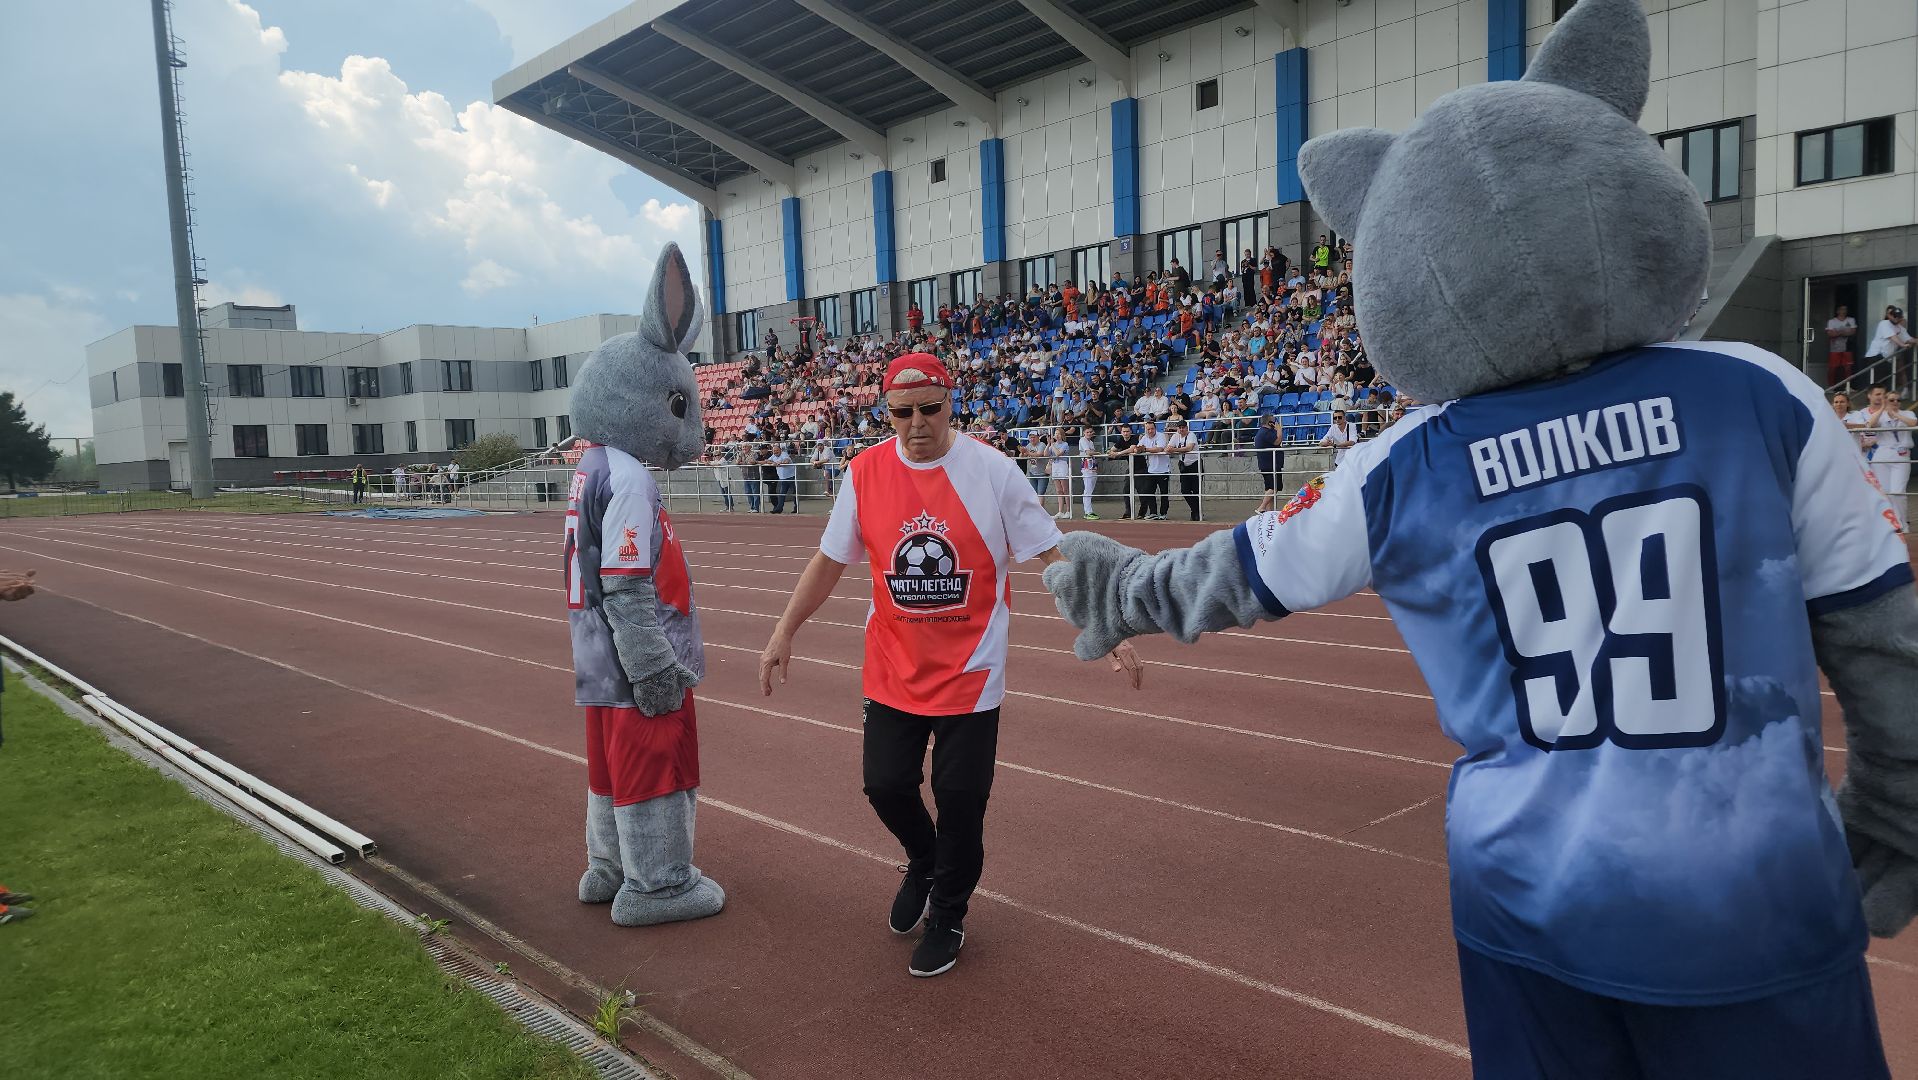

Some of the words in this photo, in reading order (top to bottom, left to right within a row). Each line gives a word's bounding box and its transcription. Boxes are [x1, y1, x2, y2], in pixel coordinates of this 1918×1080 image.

[1469, 396, 1681, 497] ВОЛКОВ
[891, 578, 918, 592] МАТЧ
[921, 577, 962, 592] ЛЕГЕНД
[927, 593, 960, 601] РОССИИ
[1485, 493, 1719, 746] 99
